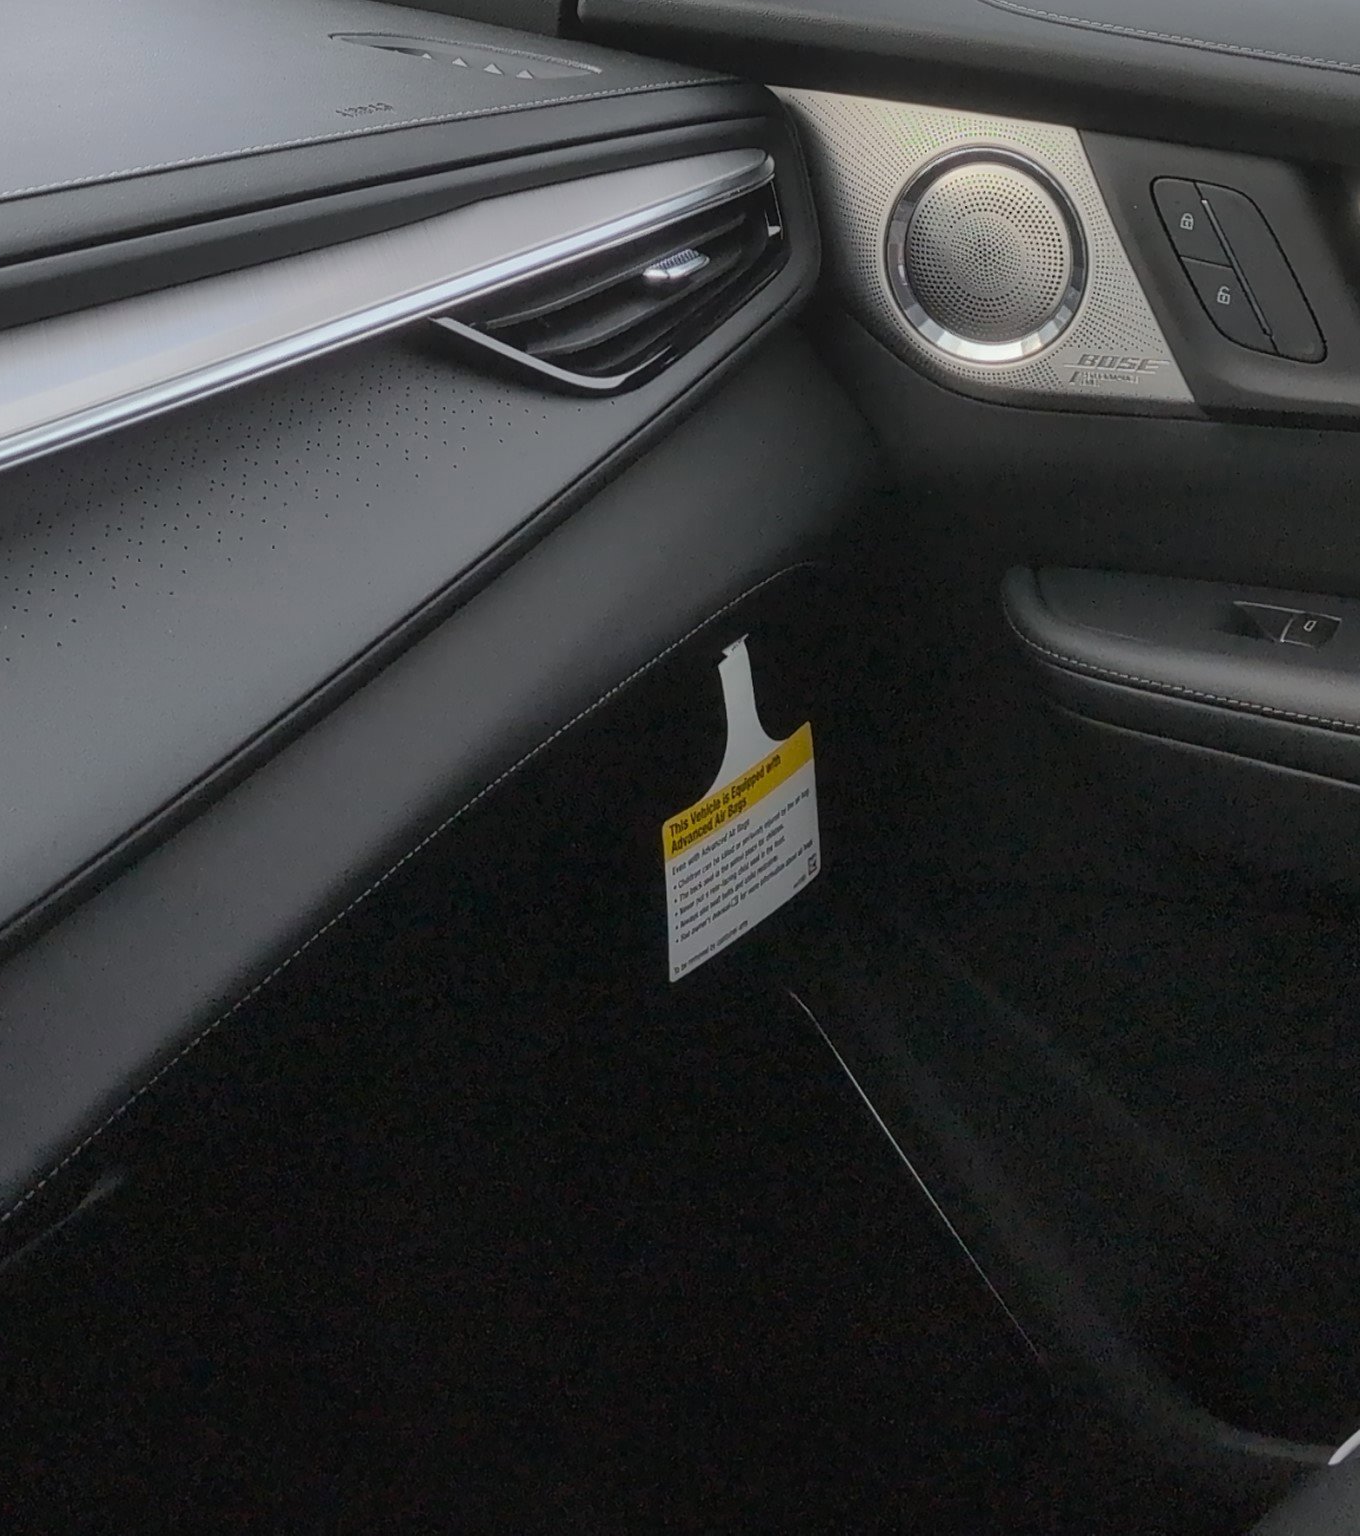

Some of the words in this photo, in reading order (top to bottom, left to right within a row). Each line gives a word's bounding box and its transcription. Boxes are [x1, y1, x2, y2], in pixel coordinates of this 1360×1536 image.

[1063, 353, 1171, 375] BOSE
[669, 818, 689, 837] This
[690, 799, 720, 824] Vehicle
[723, 792, 730, 804] is
[672, 818, 713, 854] Advanced
[714, 809, 726, 827] Air
[728, 797, 747, 817] Bags
